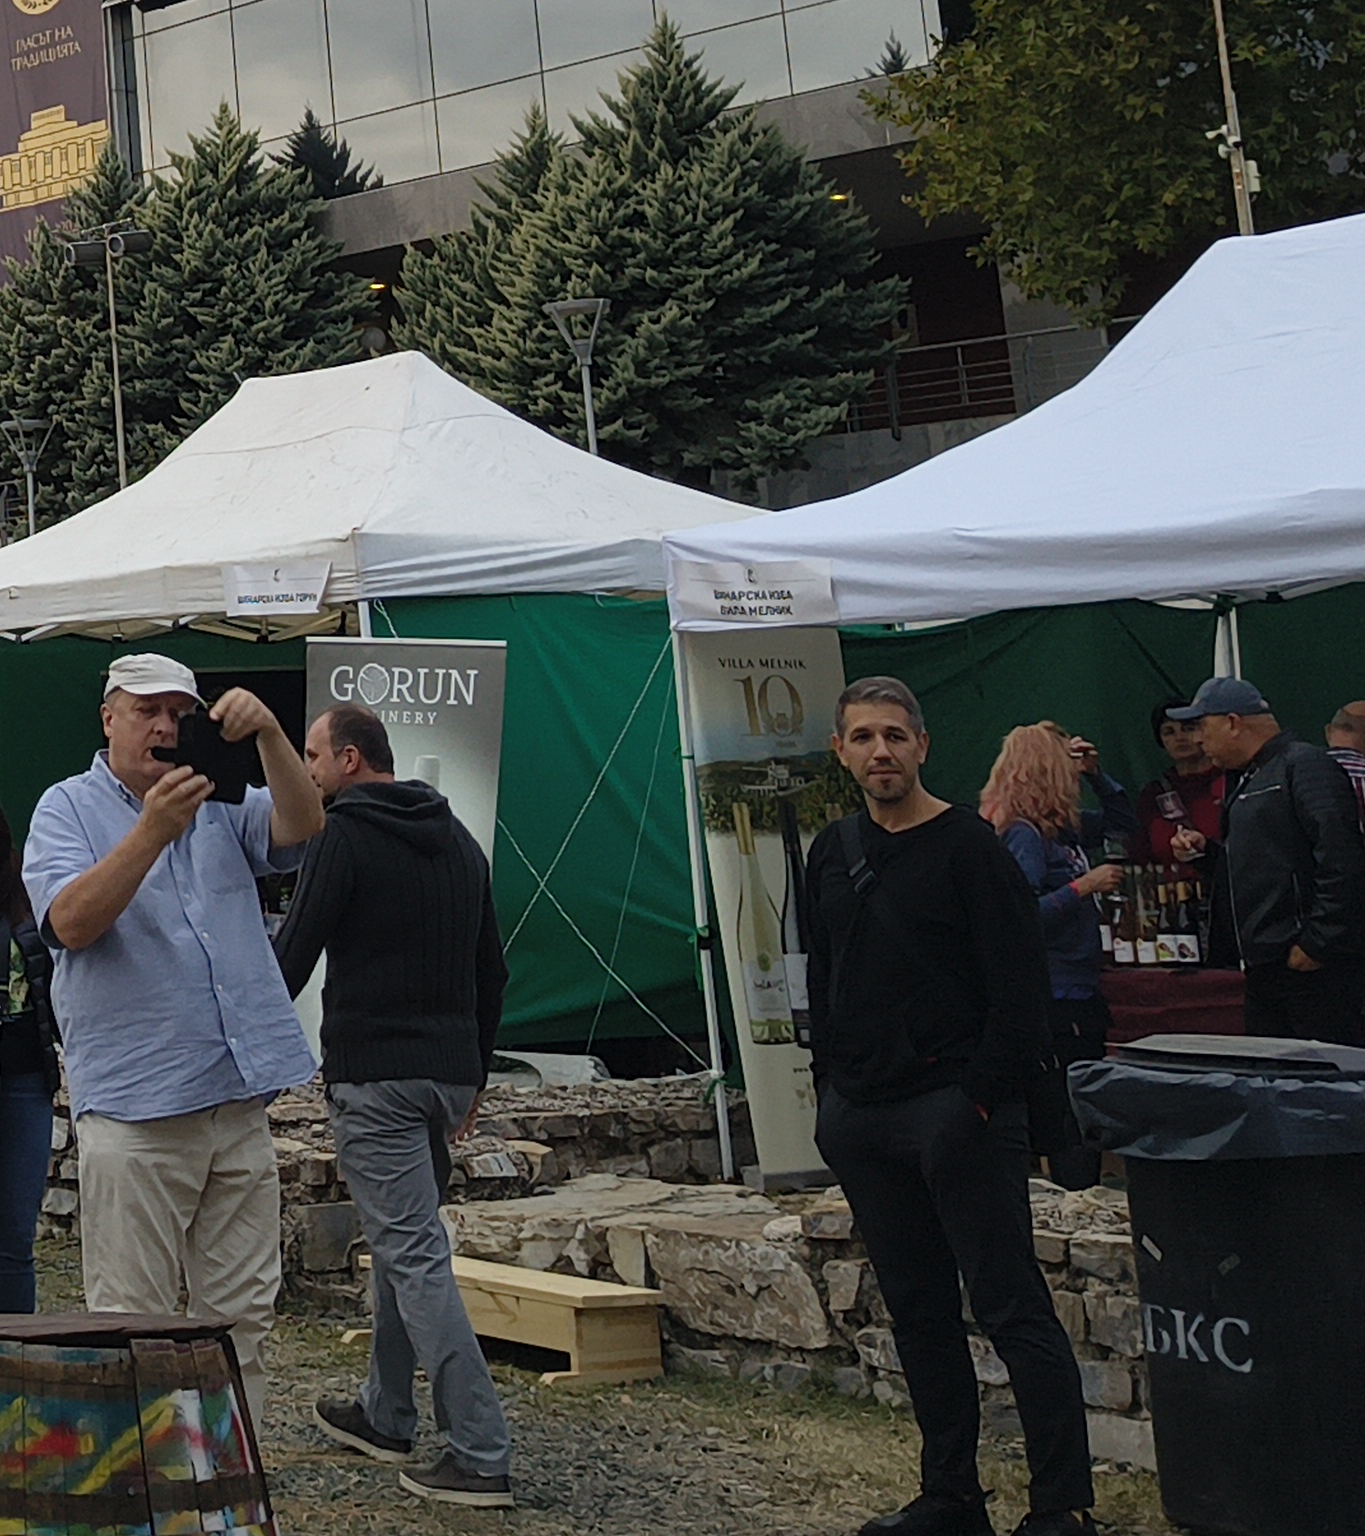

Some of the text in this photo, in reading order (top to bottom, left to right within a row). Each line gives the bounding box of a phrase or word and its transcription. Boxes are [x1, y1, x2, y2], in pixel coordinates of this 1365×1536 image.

[16, 25, 74, 53] ГЛАСЪТ НА
[11, 41, 81, 72] ТРАДИЦИЯТА
[718, 657, 807, 670] VILLA MELNIK
[330, 663, 479, 705] GORUN
[375, 710, 438, 725] INERY
[733, 674, 804, 737] 10
[1144, 1304, 1253, 1373] БКС
